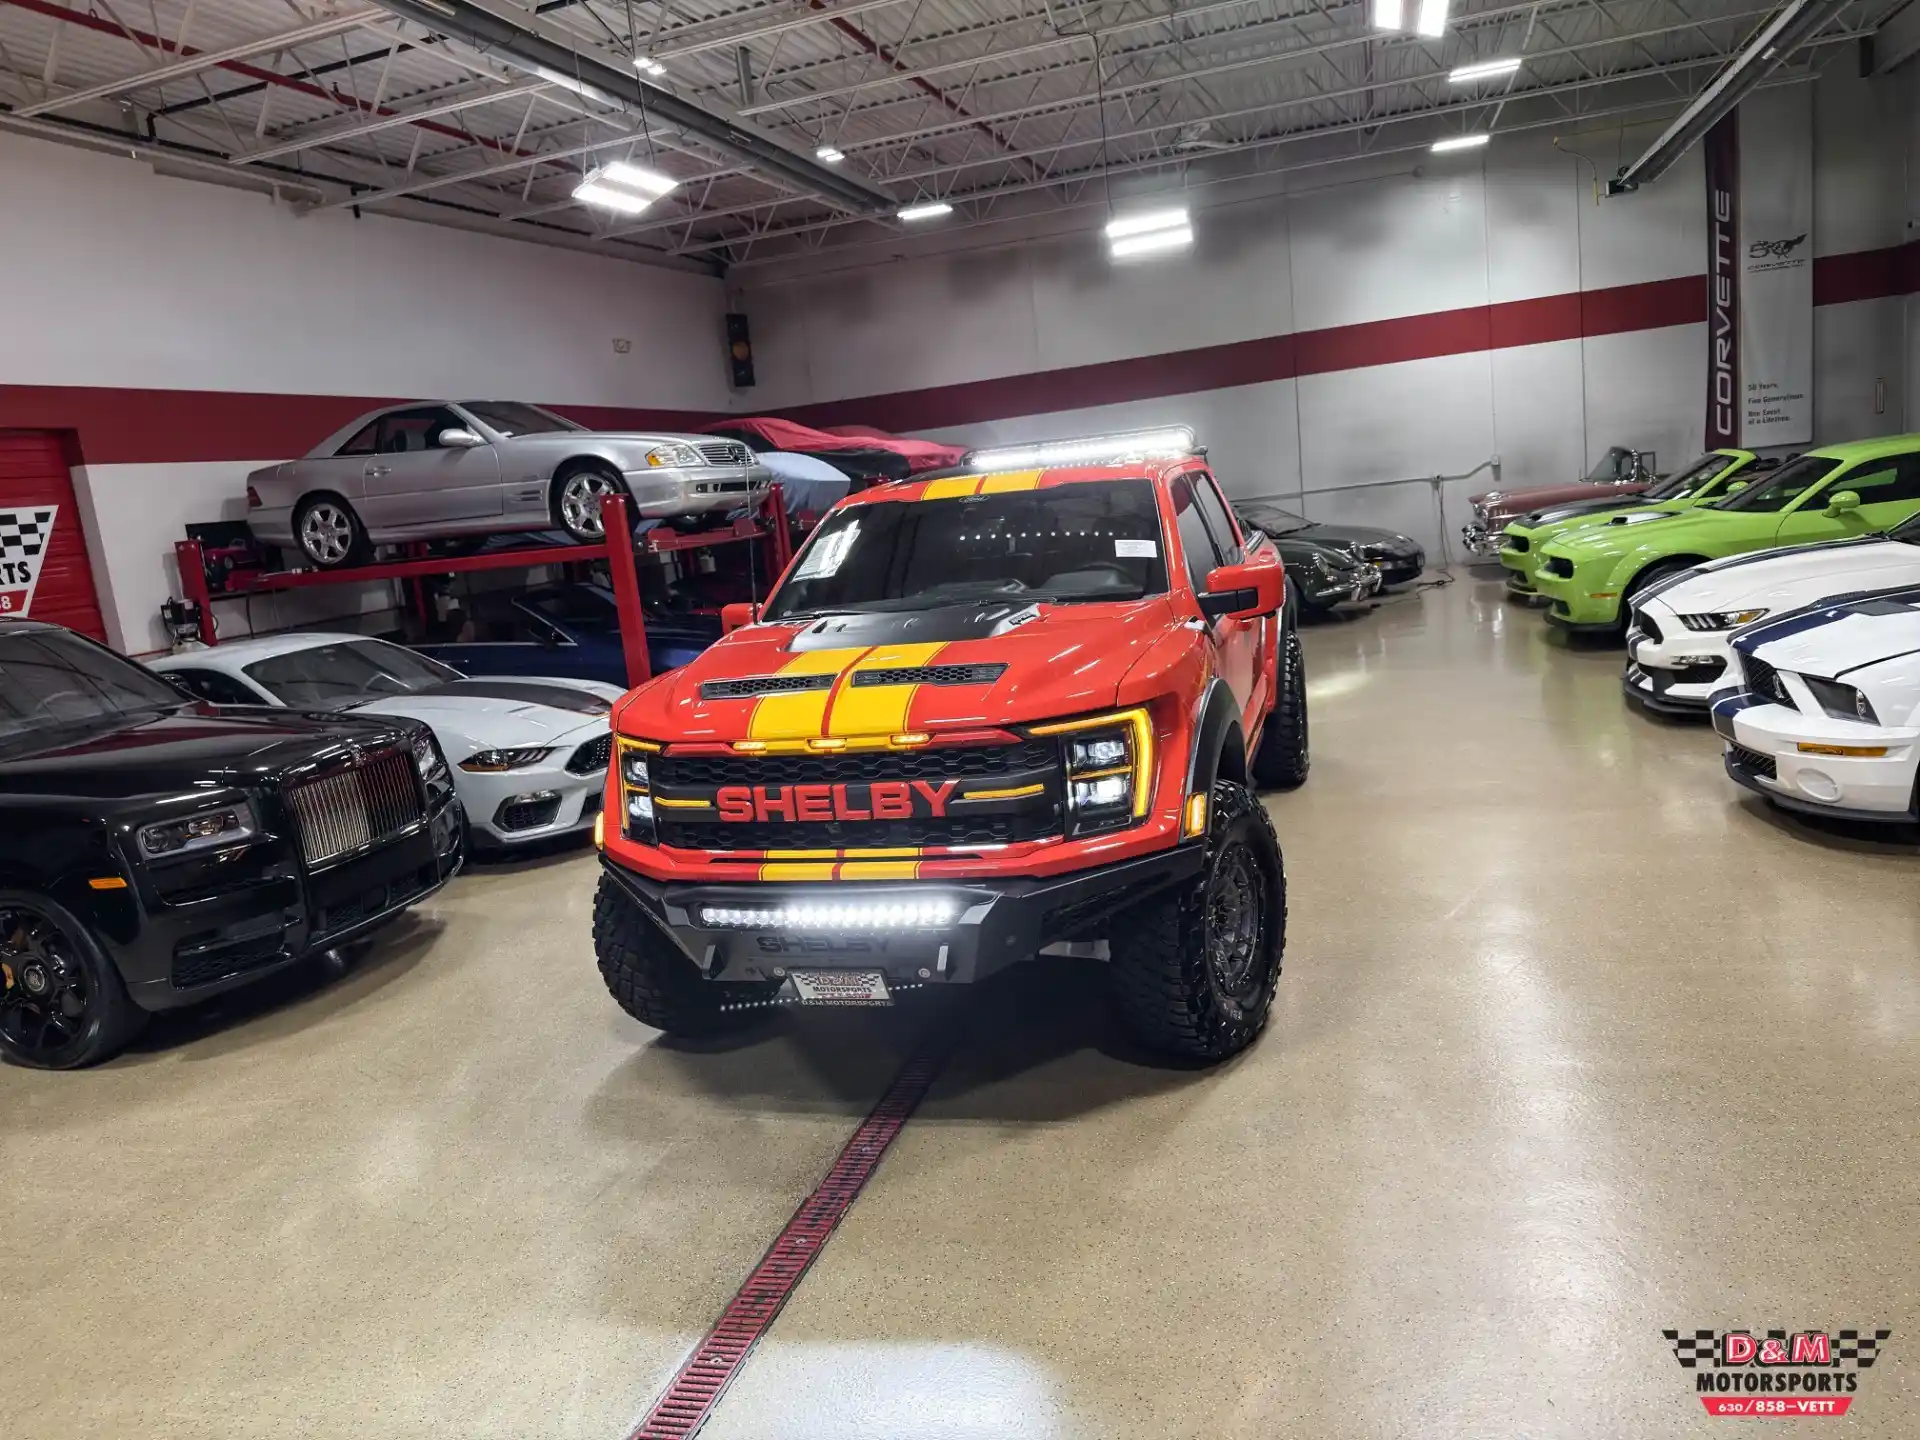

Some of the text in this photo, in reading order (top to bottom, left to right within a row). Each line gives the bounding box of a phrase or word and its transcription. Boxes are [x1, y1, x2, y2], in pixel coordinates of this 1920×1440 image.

[1715, 189, 1732, 436] CORVETTE
[0, 595, 12, 610] 8
[716, 779, 962, 822] SHELBY
[756, 936, 888, 953] SHELBY
[812, 986, 873, 994] MOTORSPORTS
